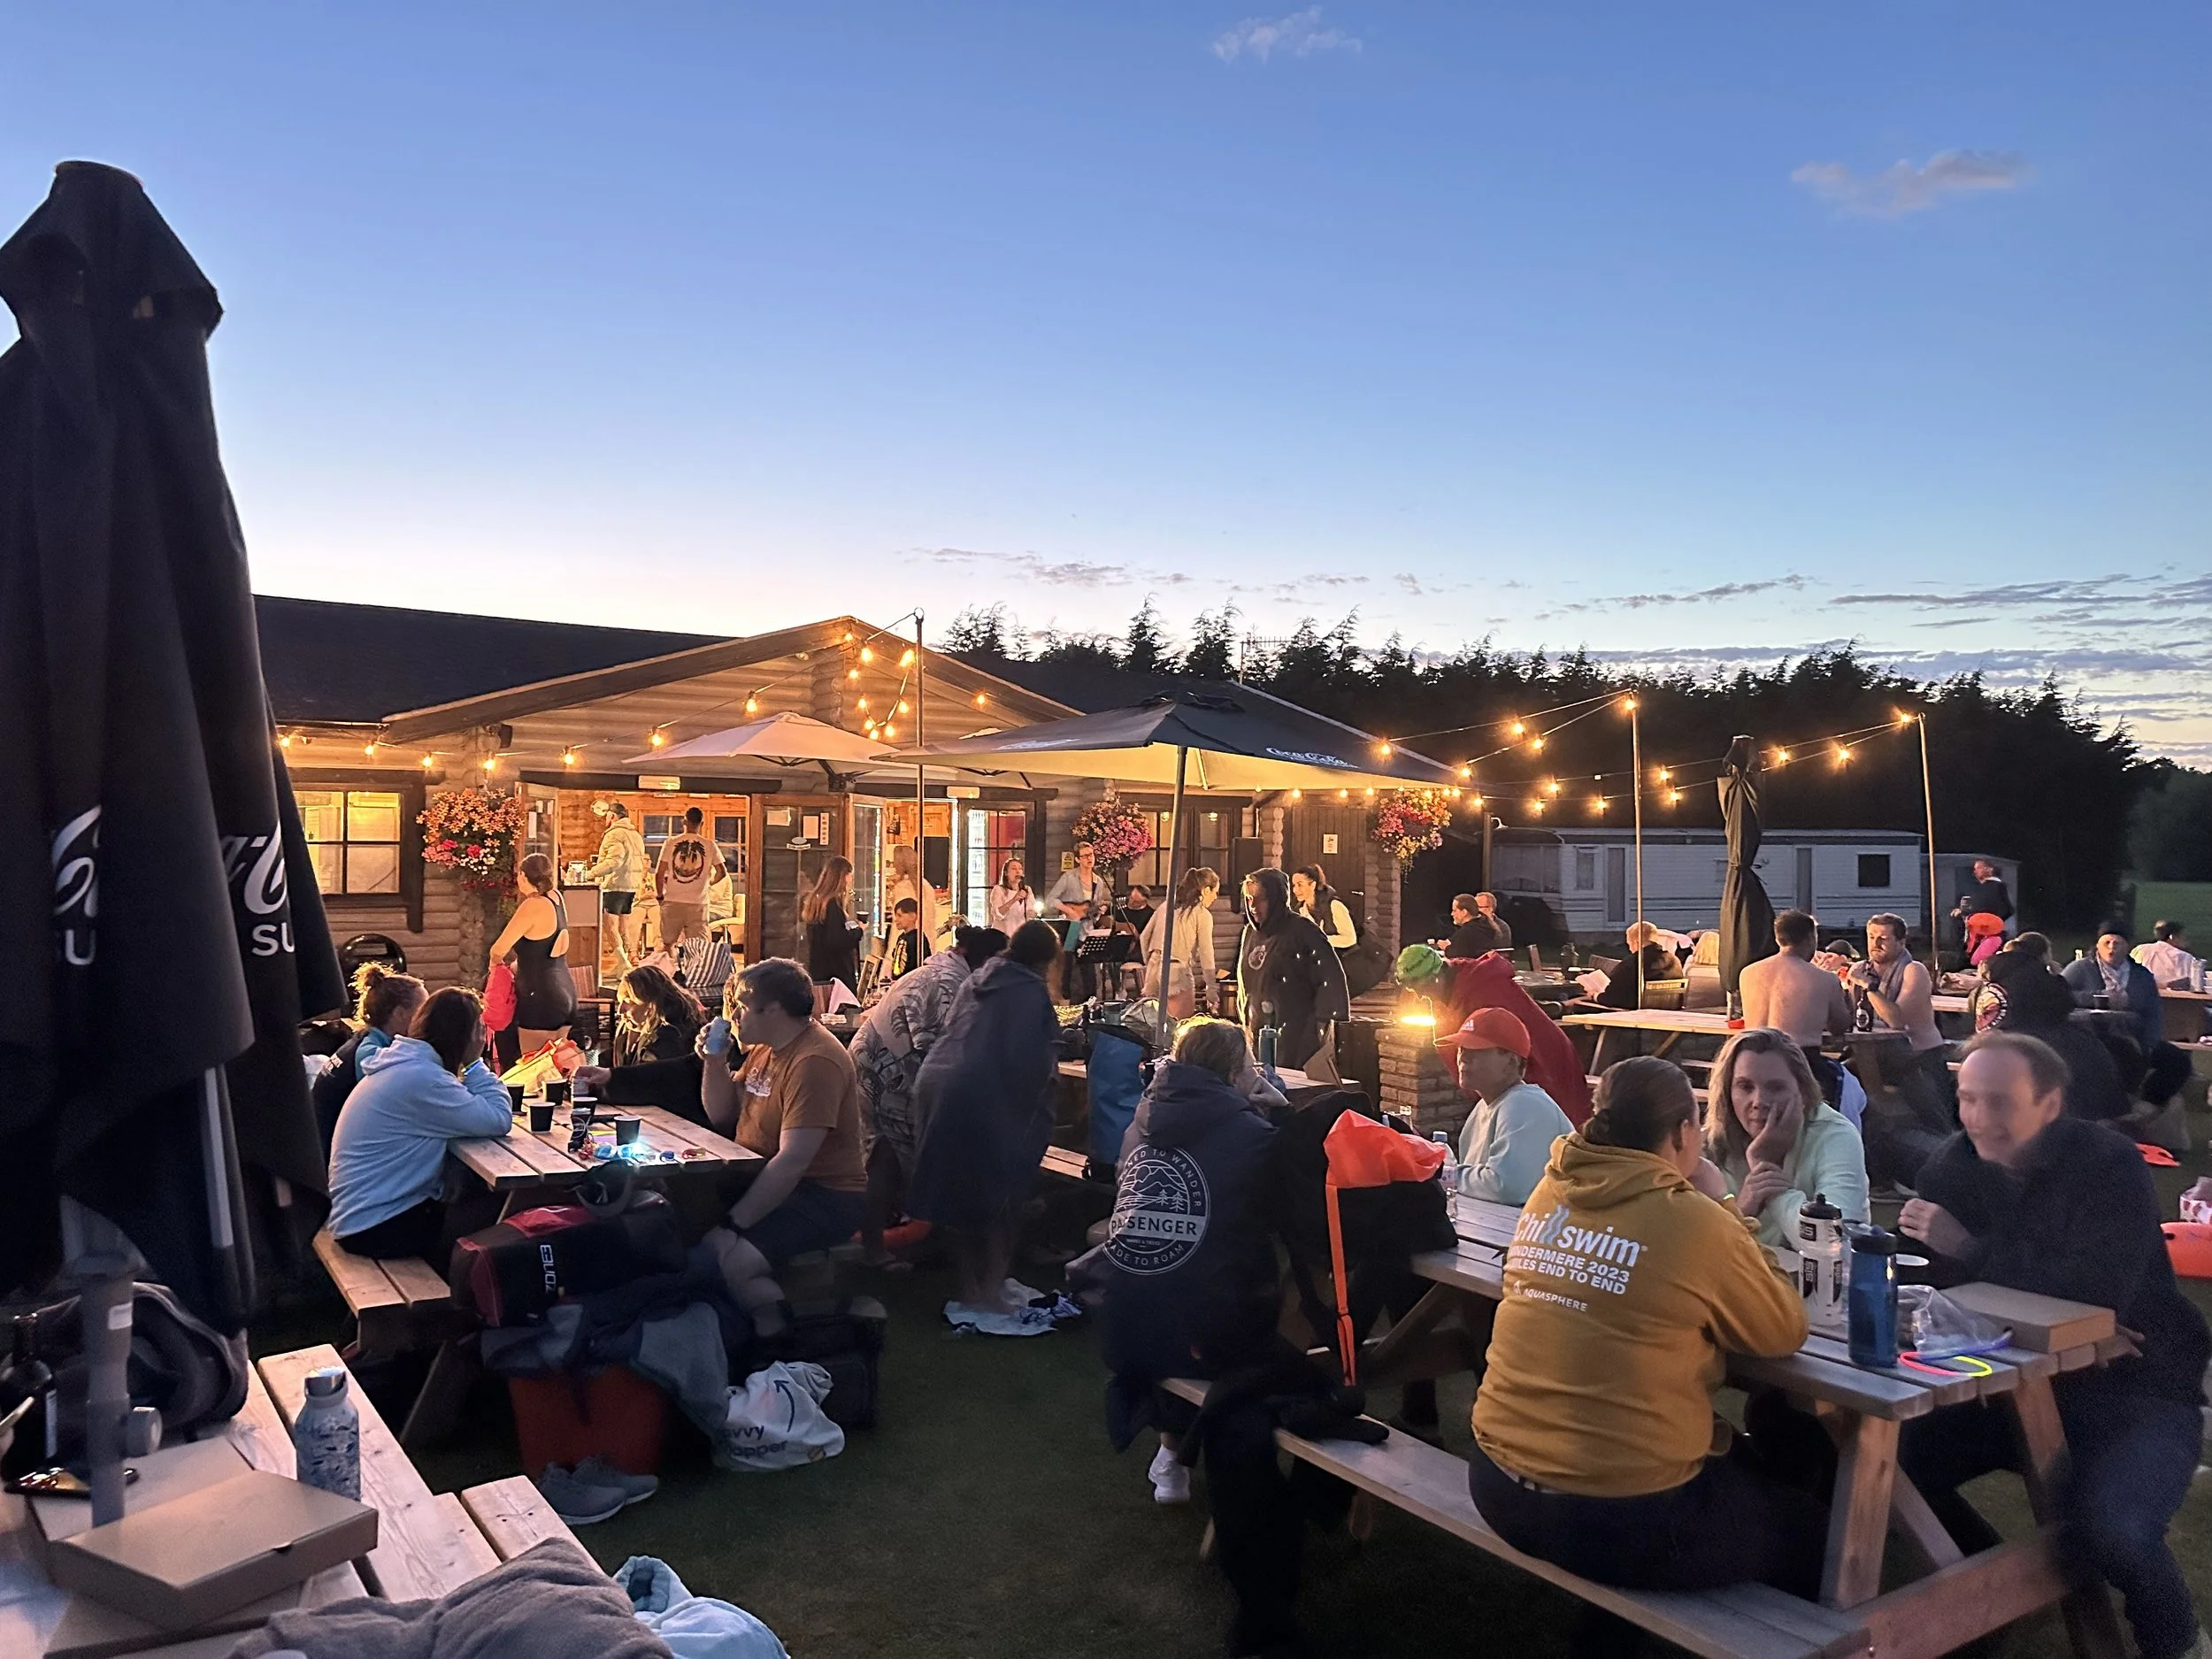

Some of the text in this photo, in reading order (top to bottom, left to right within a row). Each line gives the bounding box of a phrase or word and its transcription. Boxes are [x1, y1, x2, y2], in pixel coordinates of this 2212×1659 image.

[1171, 1154, 1202, 1207] WANDER
[1111, 1215, 1197, 1236] PASENGER
[1134, 1256, 1149, 1266] TO
[1153, 1244, 1185, 1265] ROAM
[1538, 1262, 1566, 1278] END
[1569, 1270, 1589, 1284] TO
[1590, 1277, 1626, 1295] END
[1587, 1261, 1630, 1283] 2023
[1523, 1287, 1588, 1312] AQUASPHERE
